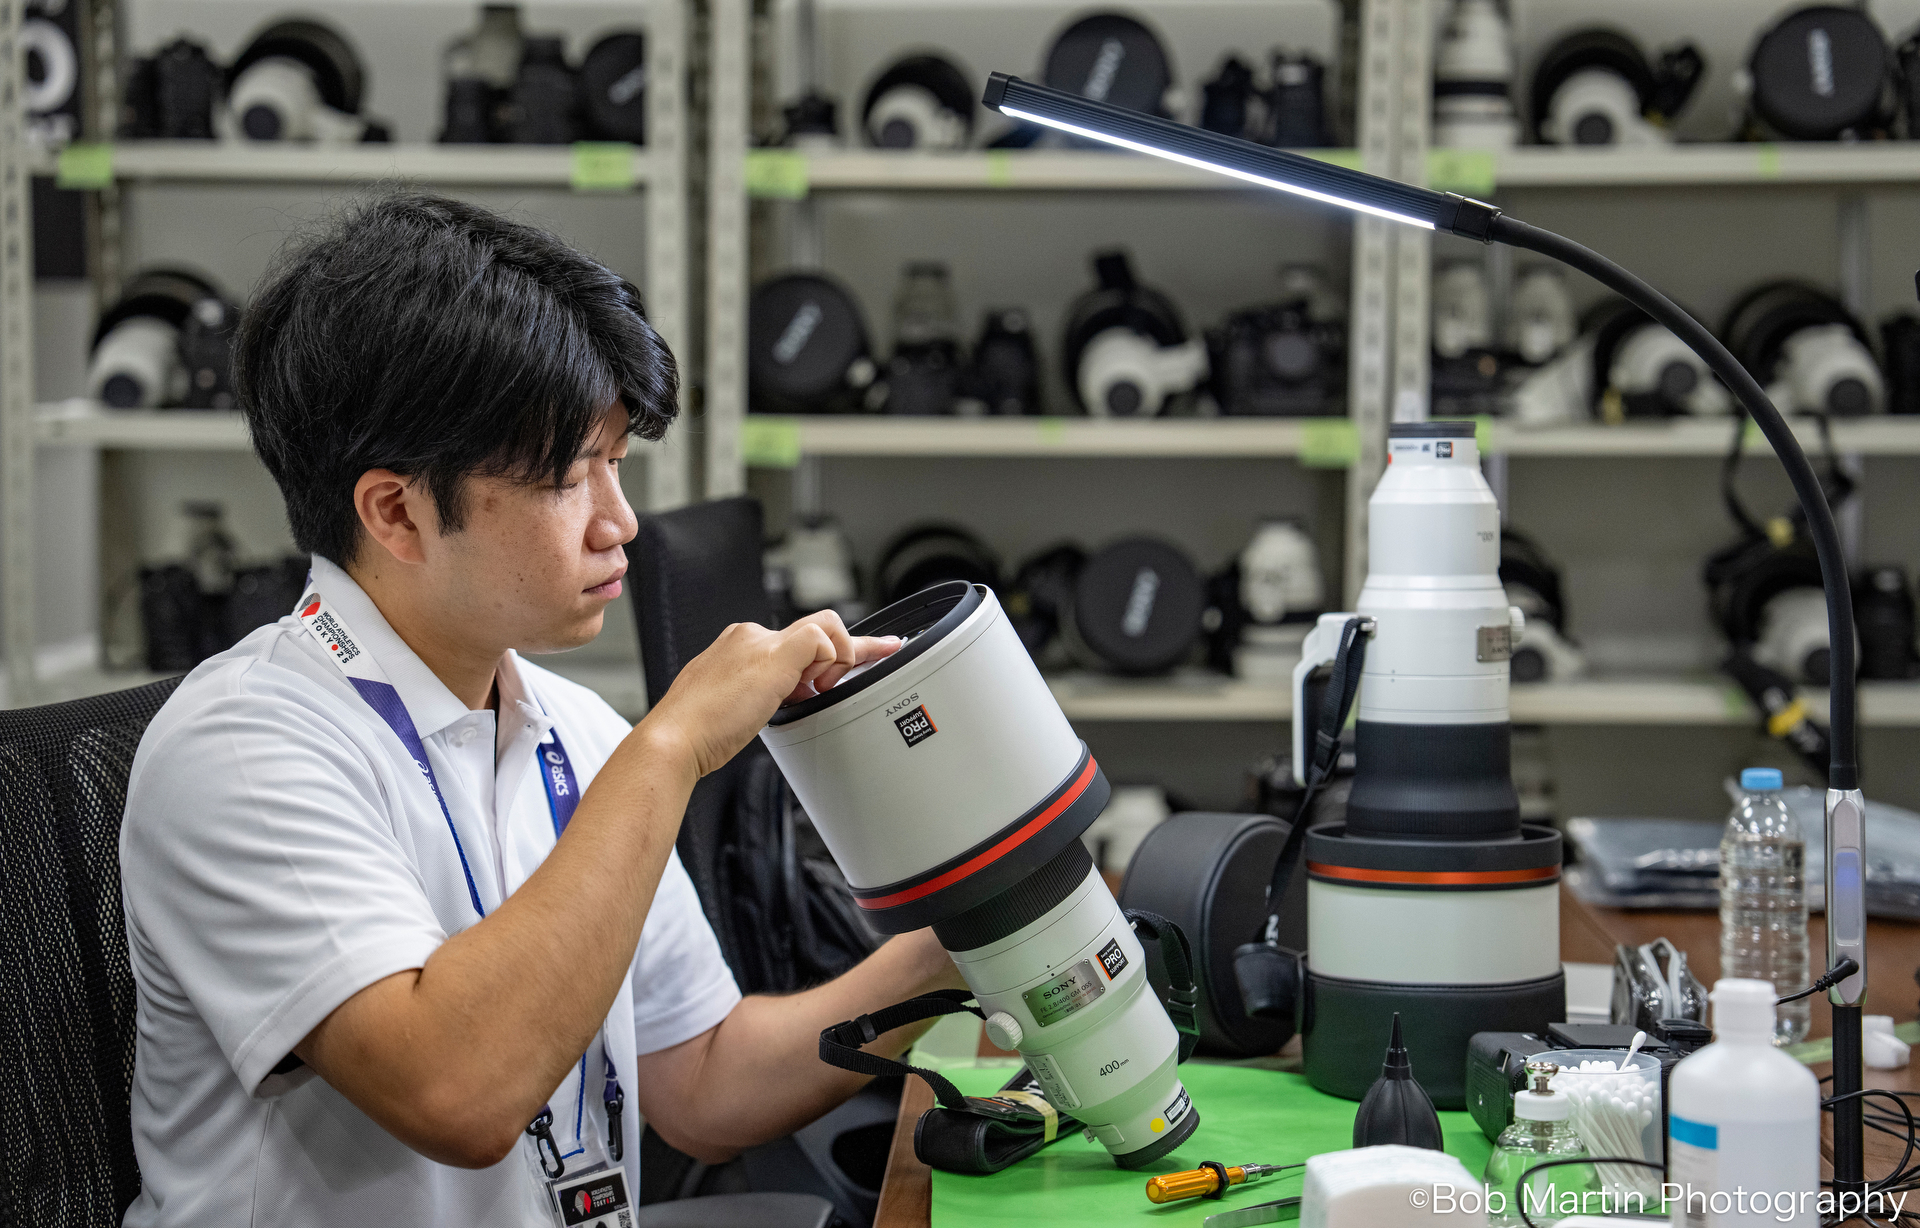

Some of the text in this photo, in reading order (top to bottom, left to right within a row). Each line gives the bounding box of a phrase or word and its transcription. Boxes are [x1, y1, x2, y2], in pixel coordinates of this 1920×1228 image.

[316, 615, 355, 660] CHAMPIONSHIPS
[322, 610, 361, 656] WORLD ATHLETICS
[336, 651, 350, 664] 25
[885, 692, 919, 717] SONY
[899, 710, 923, 728] SUPPORT
[903, 716, 929, 737] PRO
[1104, 948, 1122, 969] PRO
[1109, 957, 1126, 975] SUPPORT
[1043, 975, 1076, 1000] SONY
[1048, 995, 1070, 1009] 2.8/400
[1070, 988, 1081, 998] GM
[1081, 981, 1092, 991] OSS
[1099, 1058, 1130, 1077] 400 mm
